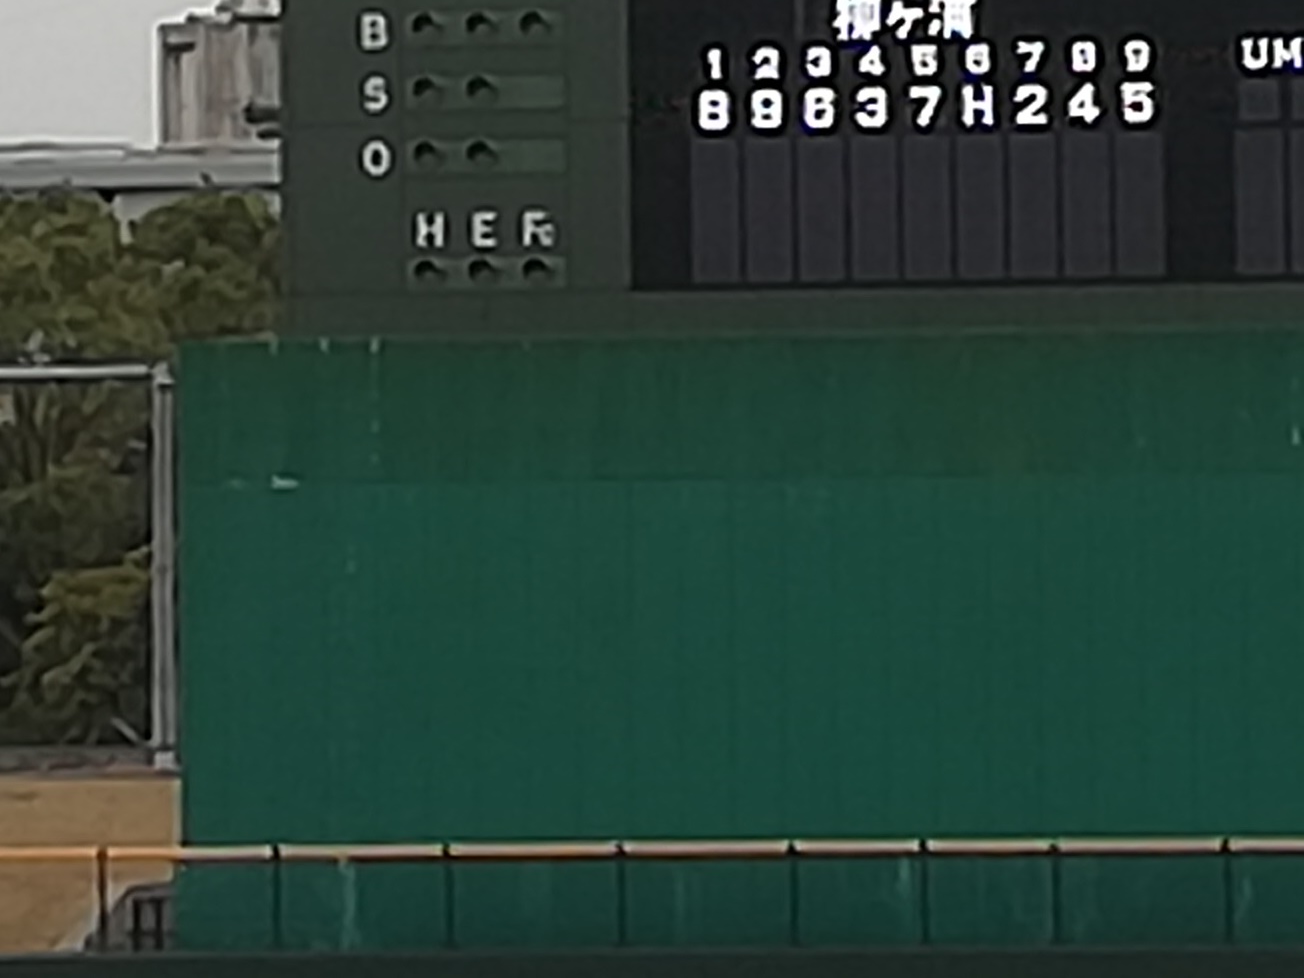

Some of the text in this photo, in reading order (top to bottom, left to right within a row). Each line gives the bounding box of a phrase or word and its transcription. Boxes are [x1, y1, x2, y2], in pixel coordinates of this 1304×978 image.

[361, 13, 388, 50] B
[708, 49, 721, 79] 1
[753, 48, 779, 79] 2
[807, 47, 831, 77] 3
[859, 46, 884, 75] 4
[911, 45, 937, 75] 5
[966, 44, 990, 74] 6
[1017, 42, 1044, 72] 7
[364, 76, 388, 111] S
[856, 87, 887, 127] 3
[910, 86, 941, 126] 7
[962, 85, 993, 126] H
[1014, 85, 1047, 124] 2
[1069, 83, 1099, 123] 4
[1121, 82, 1153, 122] 5
[416, 213, 444, 247] H
[472, 212, 497, 247] E
